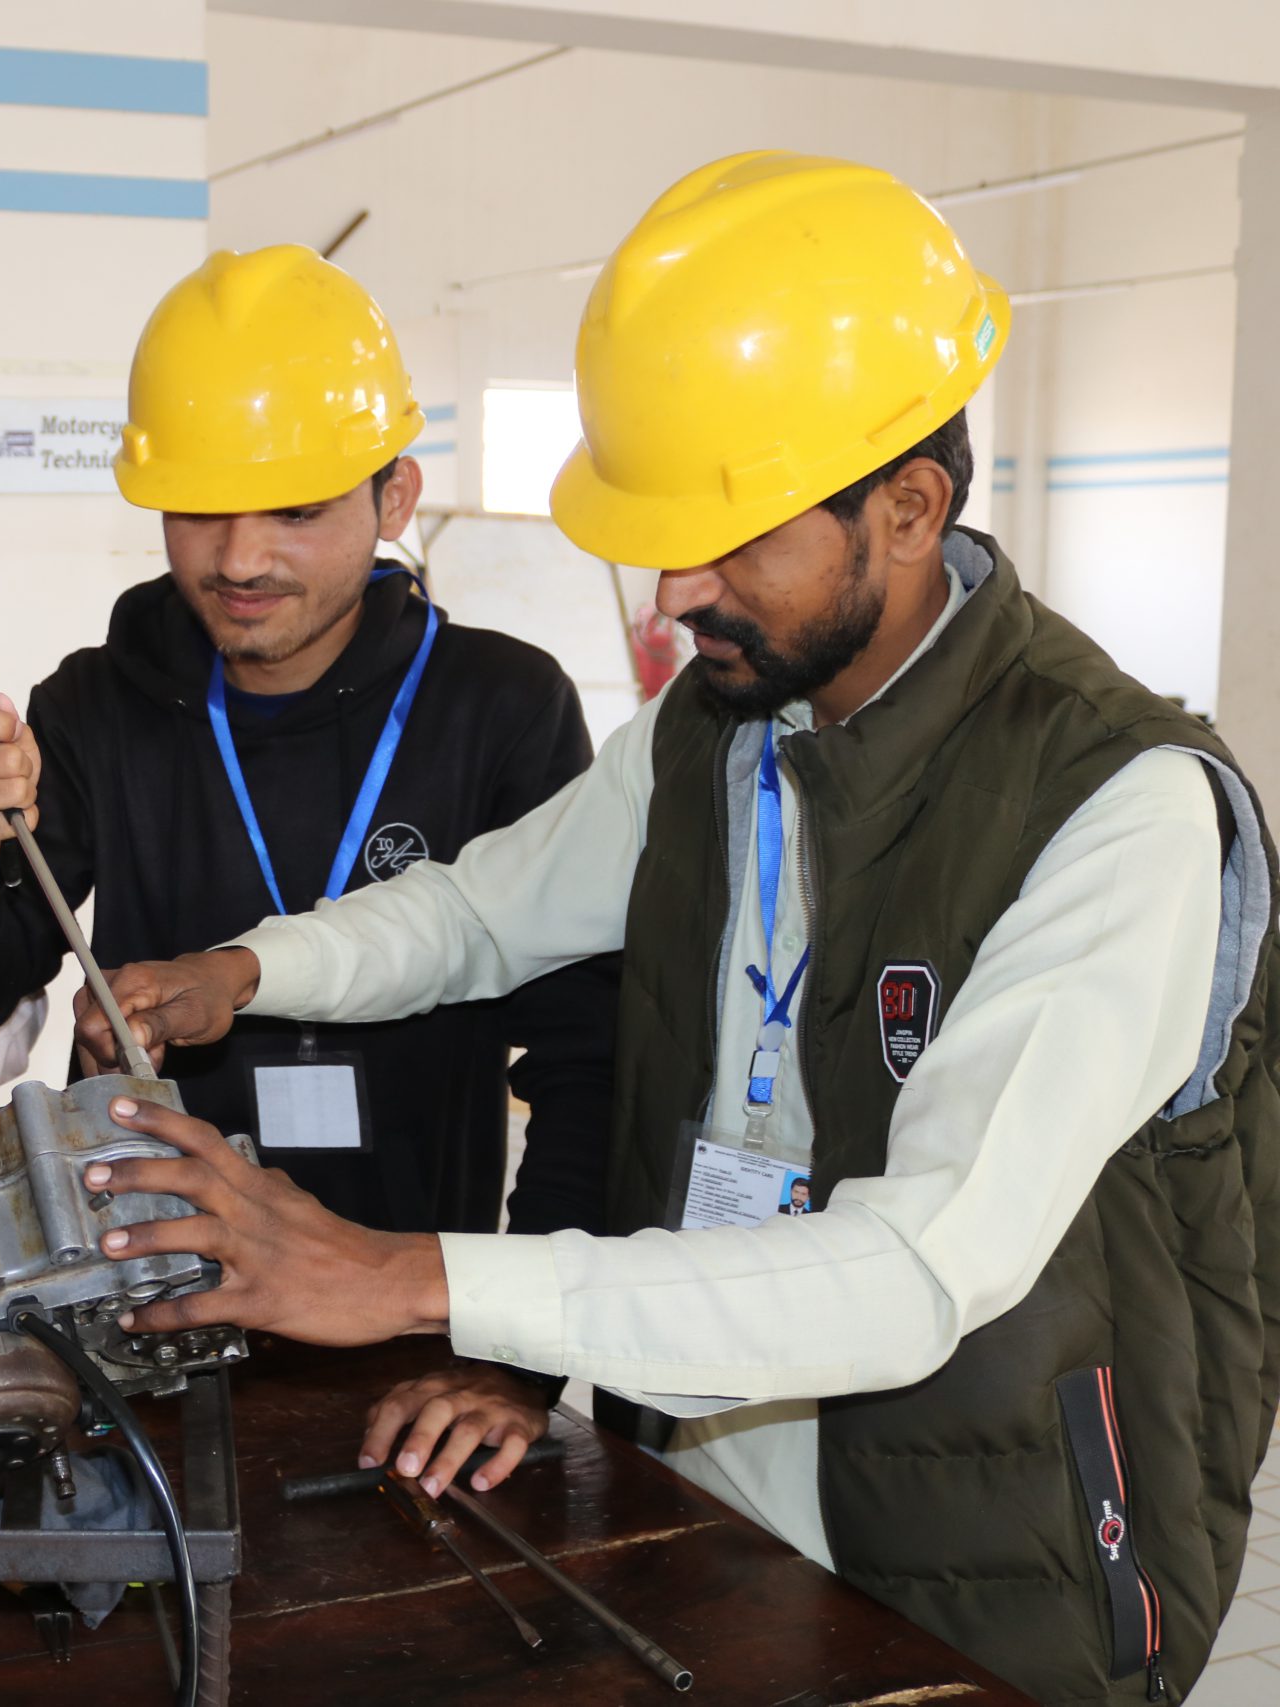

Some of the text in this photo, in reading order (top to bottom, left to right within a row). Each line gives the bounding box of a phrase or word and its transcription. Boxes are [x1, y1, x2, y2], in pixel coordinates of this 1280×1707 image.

[40, 415, 122, 441] Motorcy
[40, 449, 115, 469] Techni
[882, 981, 914, 1020] 80
